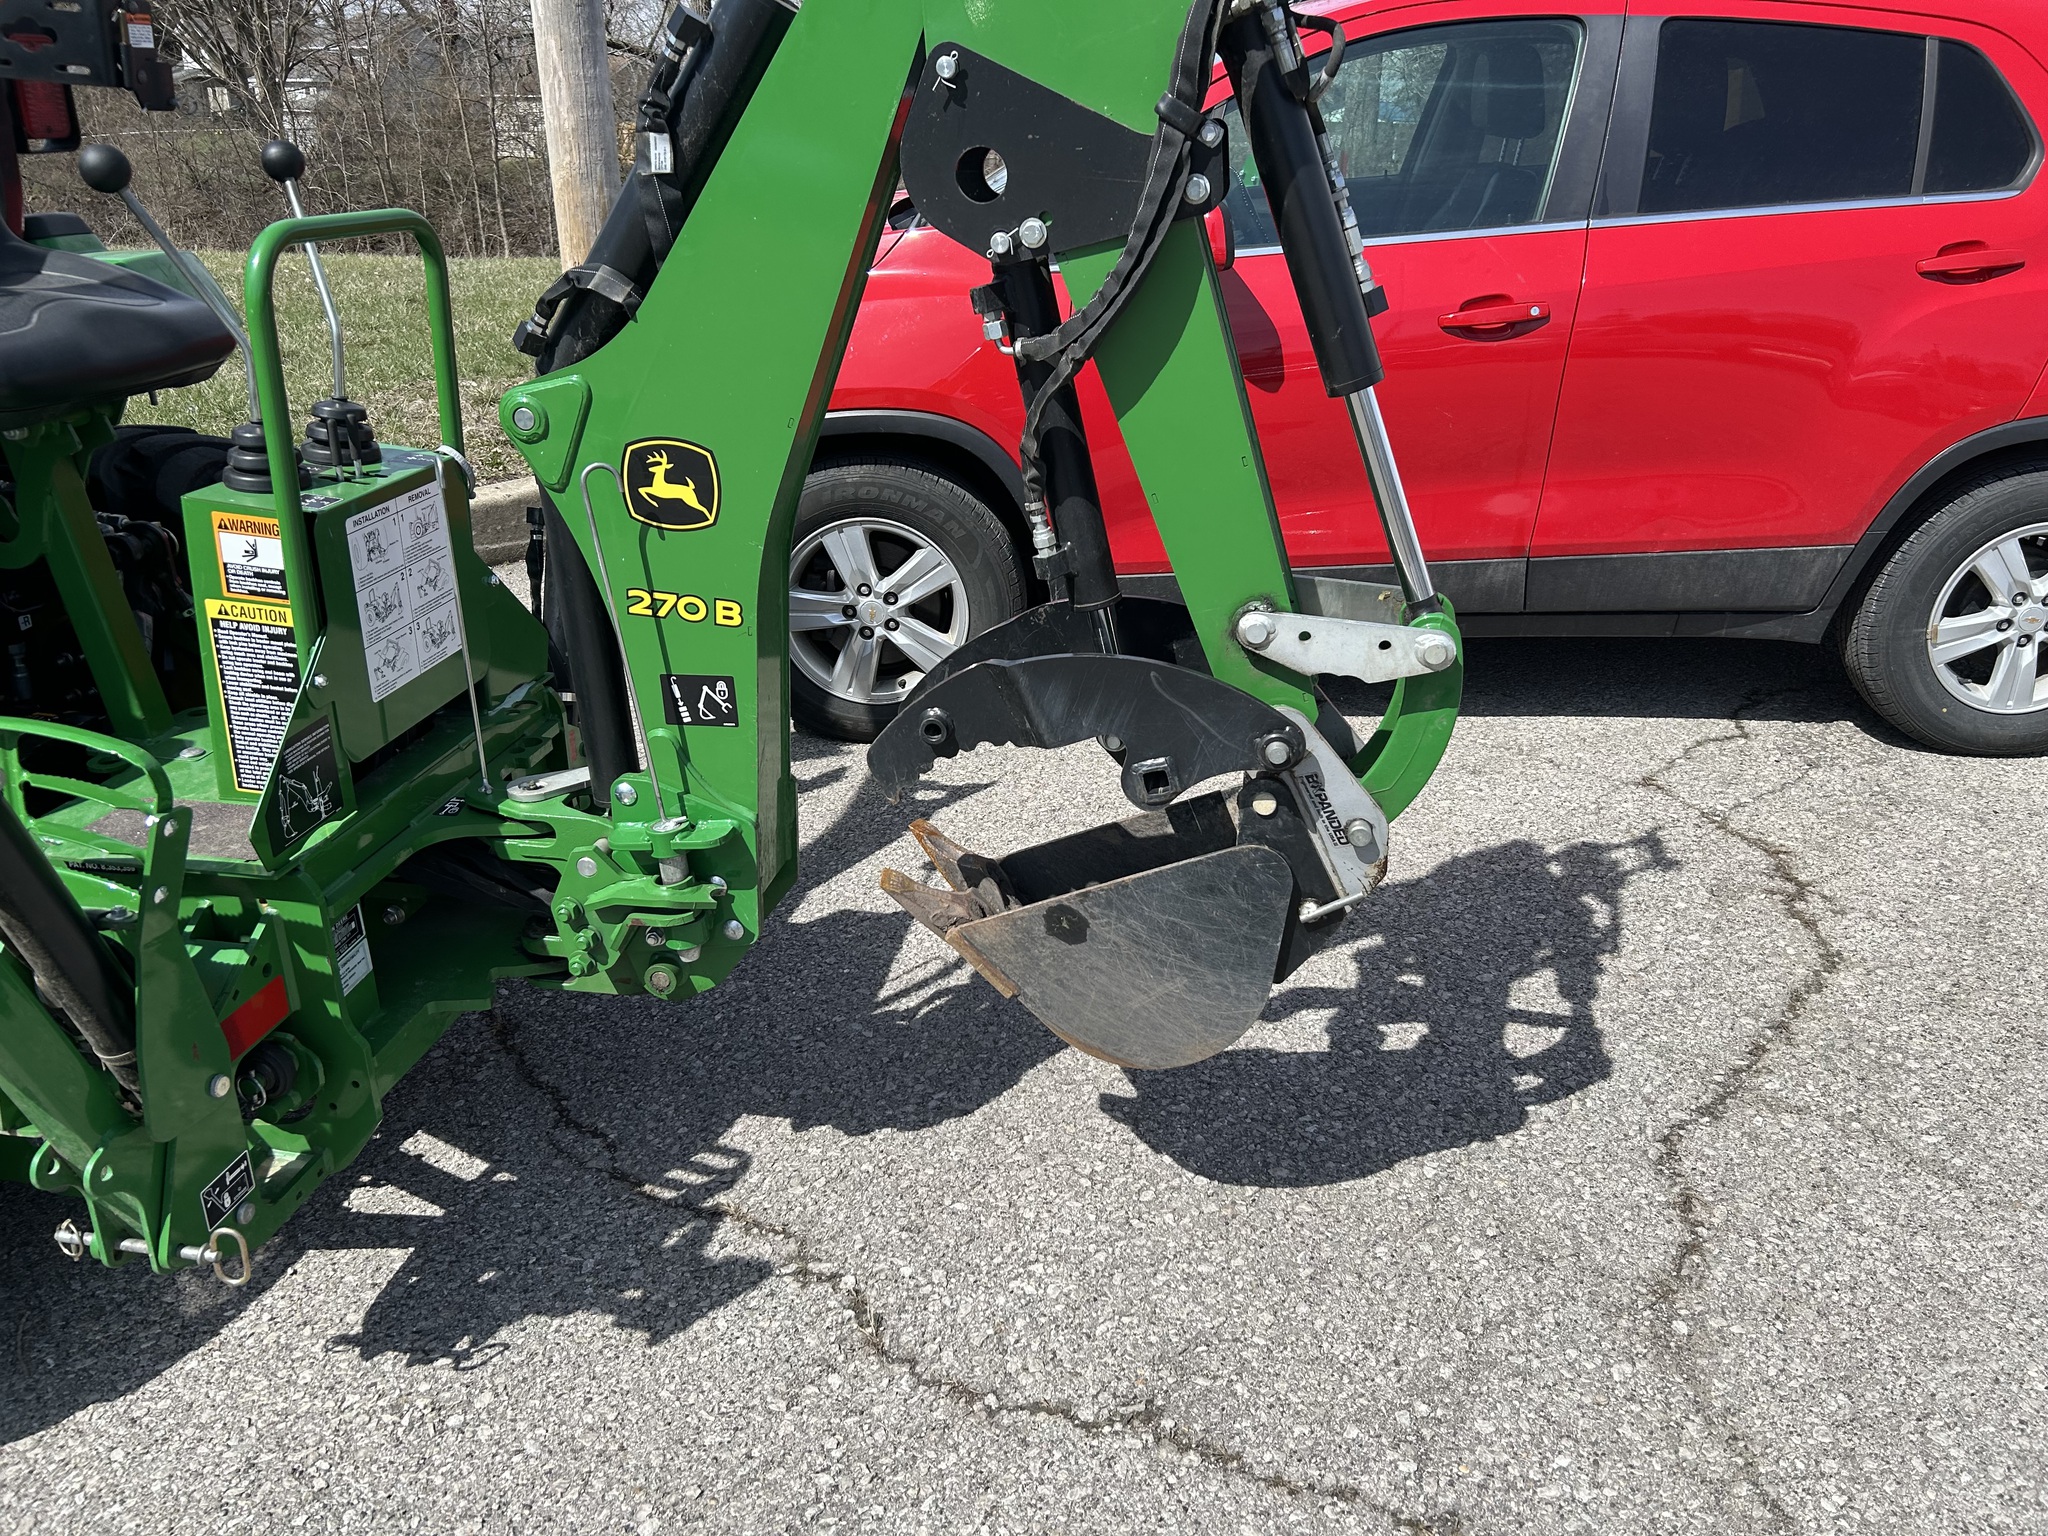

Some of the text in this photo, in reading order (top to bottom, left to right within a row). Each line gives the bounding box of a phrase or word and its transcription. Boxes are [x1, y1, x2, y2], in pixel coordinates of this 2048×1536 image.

[228, 518, 280, 536] WARNING
[352, 488, 431, 528] INSTALLATION REMOVAL
[820, 485, 968, 540] IRONMAN
[230, 604, 287, 623] CAUTION
[626, 588, 744, 627] 270 B
[220, 621, 288, 636] HELP AVOID INJURY
[1305, 773, 1350, 846] EXPANDED
